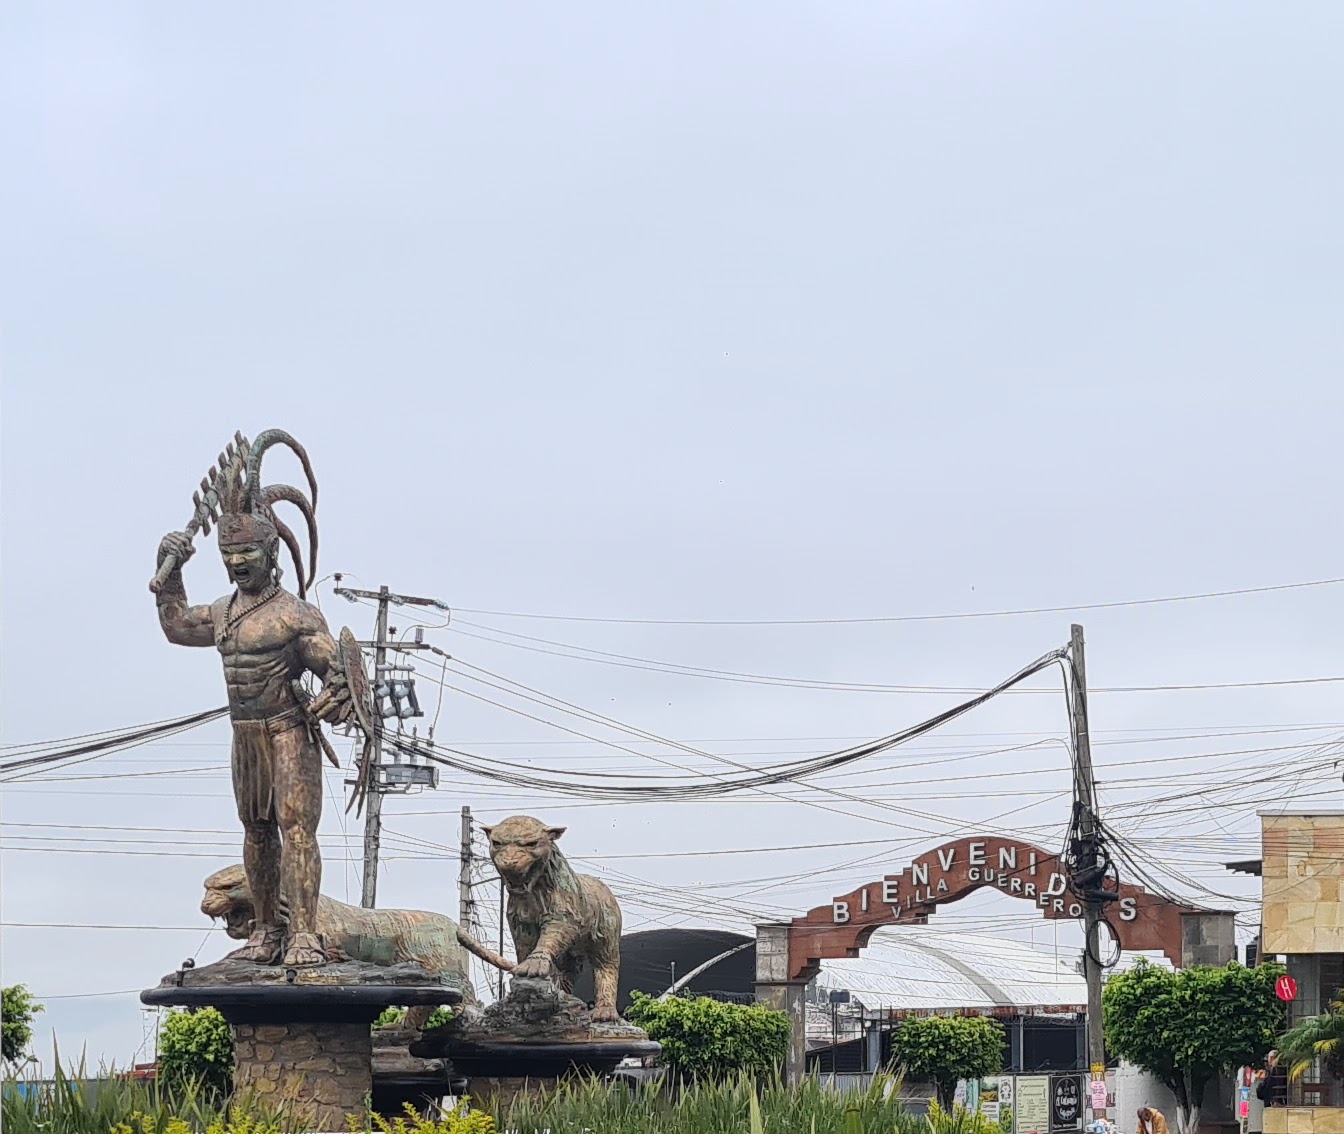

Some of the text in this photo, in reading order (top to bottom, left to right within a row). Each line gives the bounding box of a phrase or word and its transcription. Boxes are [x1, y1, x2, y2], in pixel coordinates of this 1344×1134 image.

[832, 841, 1137, 924] BIENVENIDS
[891, 867, 1083, 920] VILLA GUERRERO
